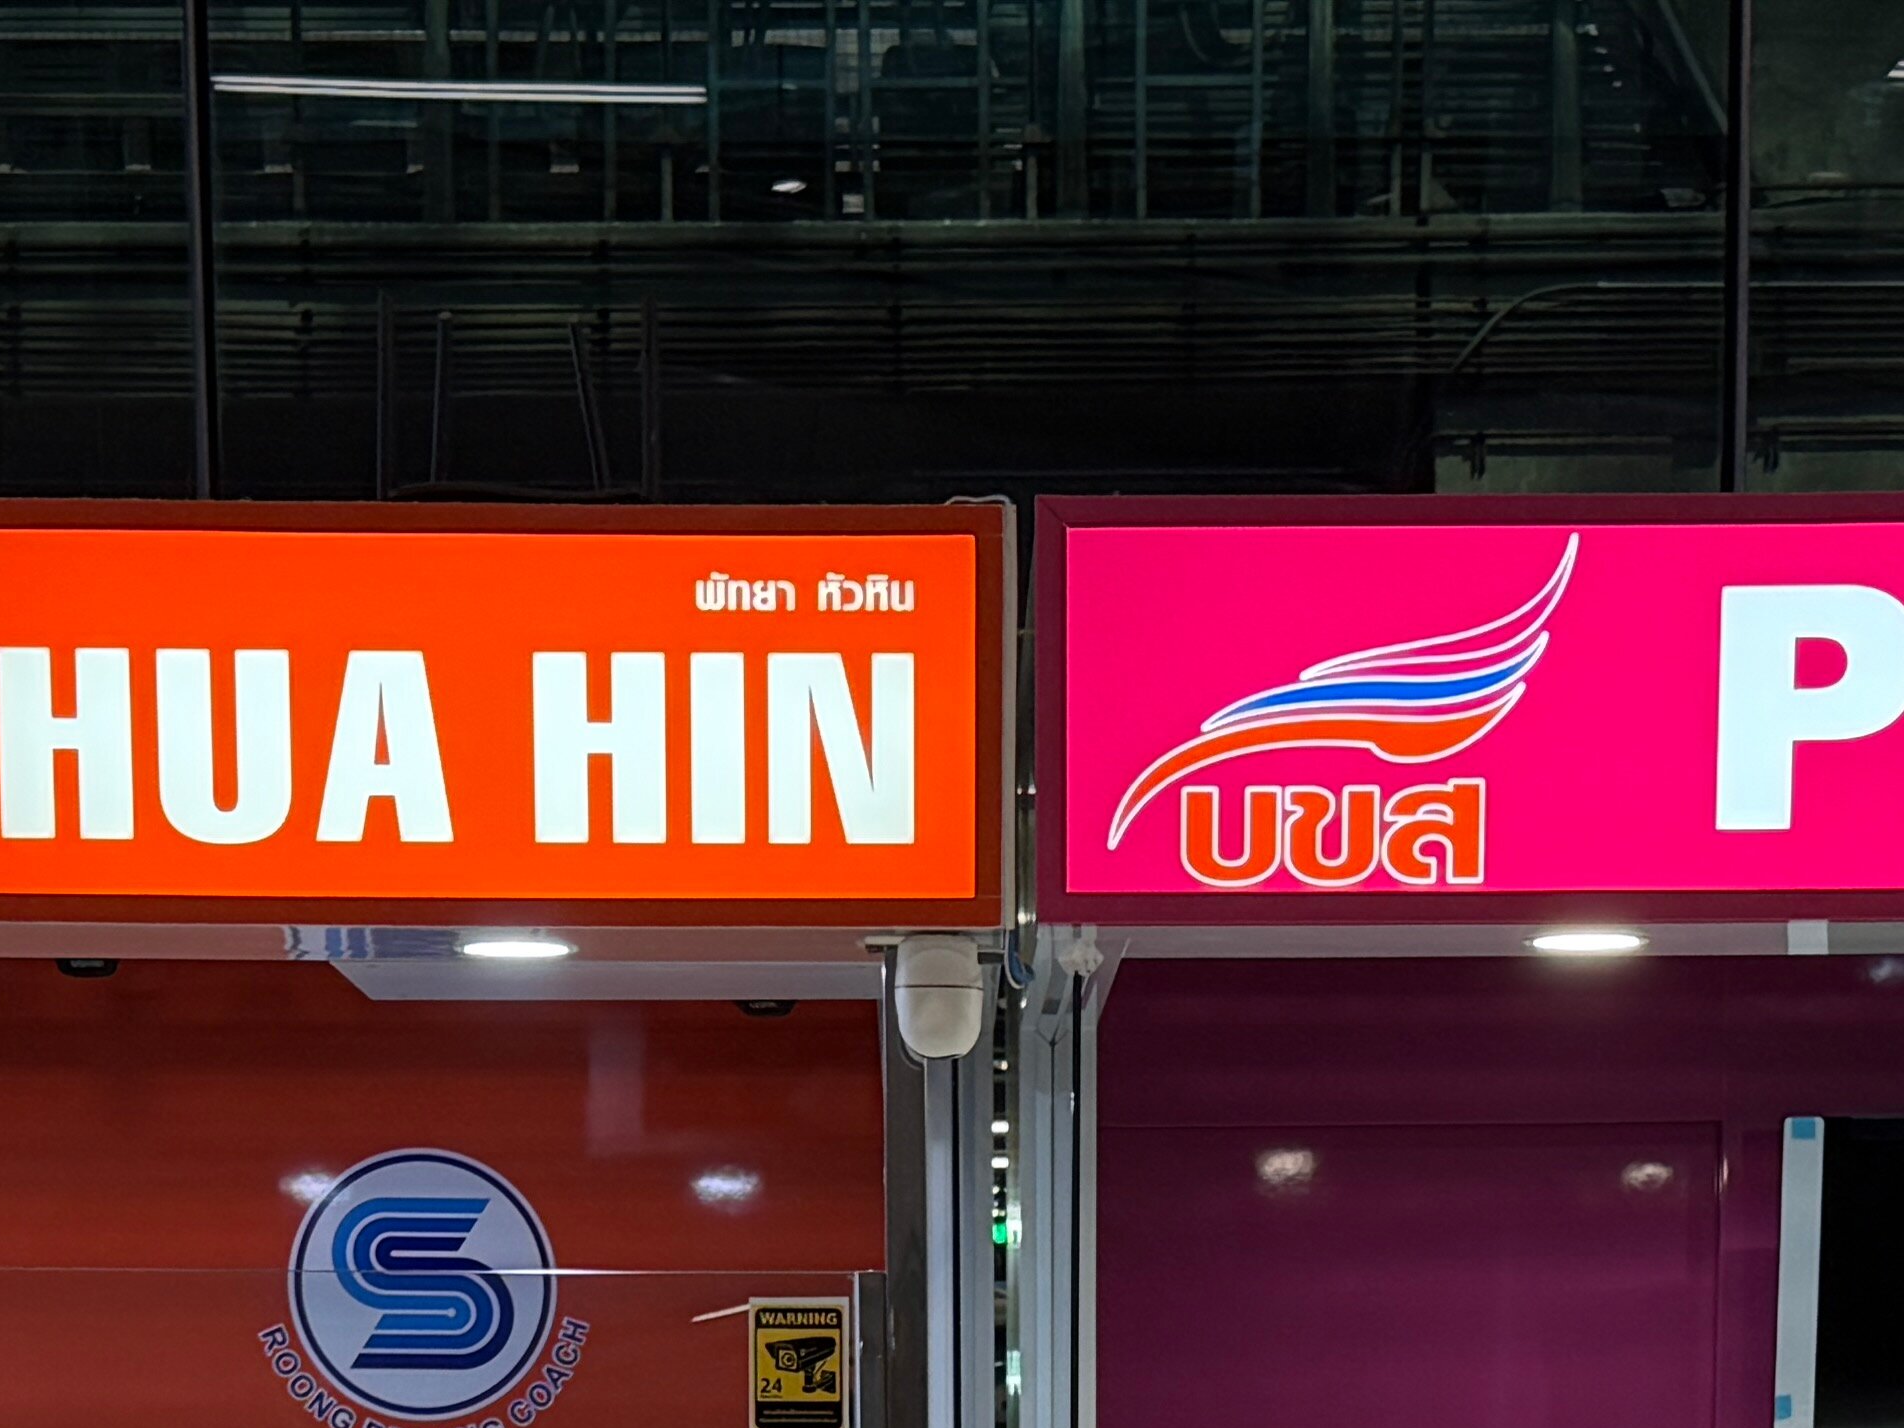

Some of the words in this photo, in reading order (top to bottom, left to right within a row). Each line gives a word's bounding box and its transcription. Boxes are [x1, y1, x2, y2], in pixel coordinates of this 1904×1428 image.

[695, 571, 796, 612] พัทยา
[817, 571, 915, 612] หัวหิน
[532, 650, 915, 845] HIN
[1178, 777, 1486, 887] บขส
[760, 1311, 838, 1326] WARNING
[509, 1316, 590, 1428] COACH
[760, 1378, 782, 1394] 24
